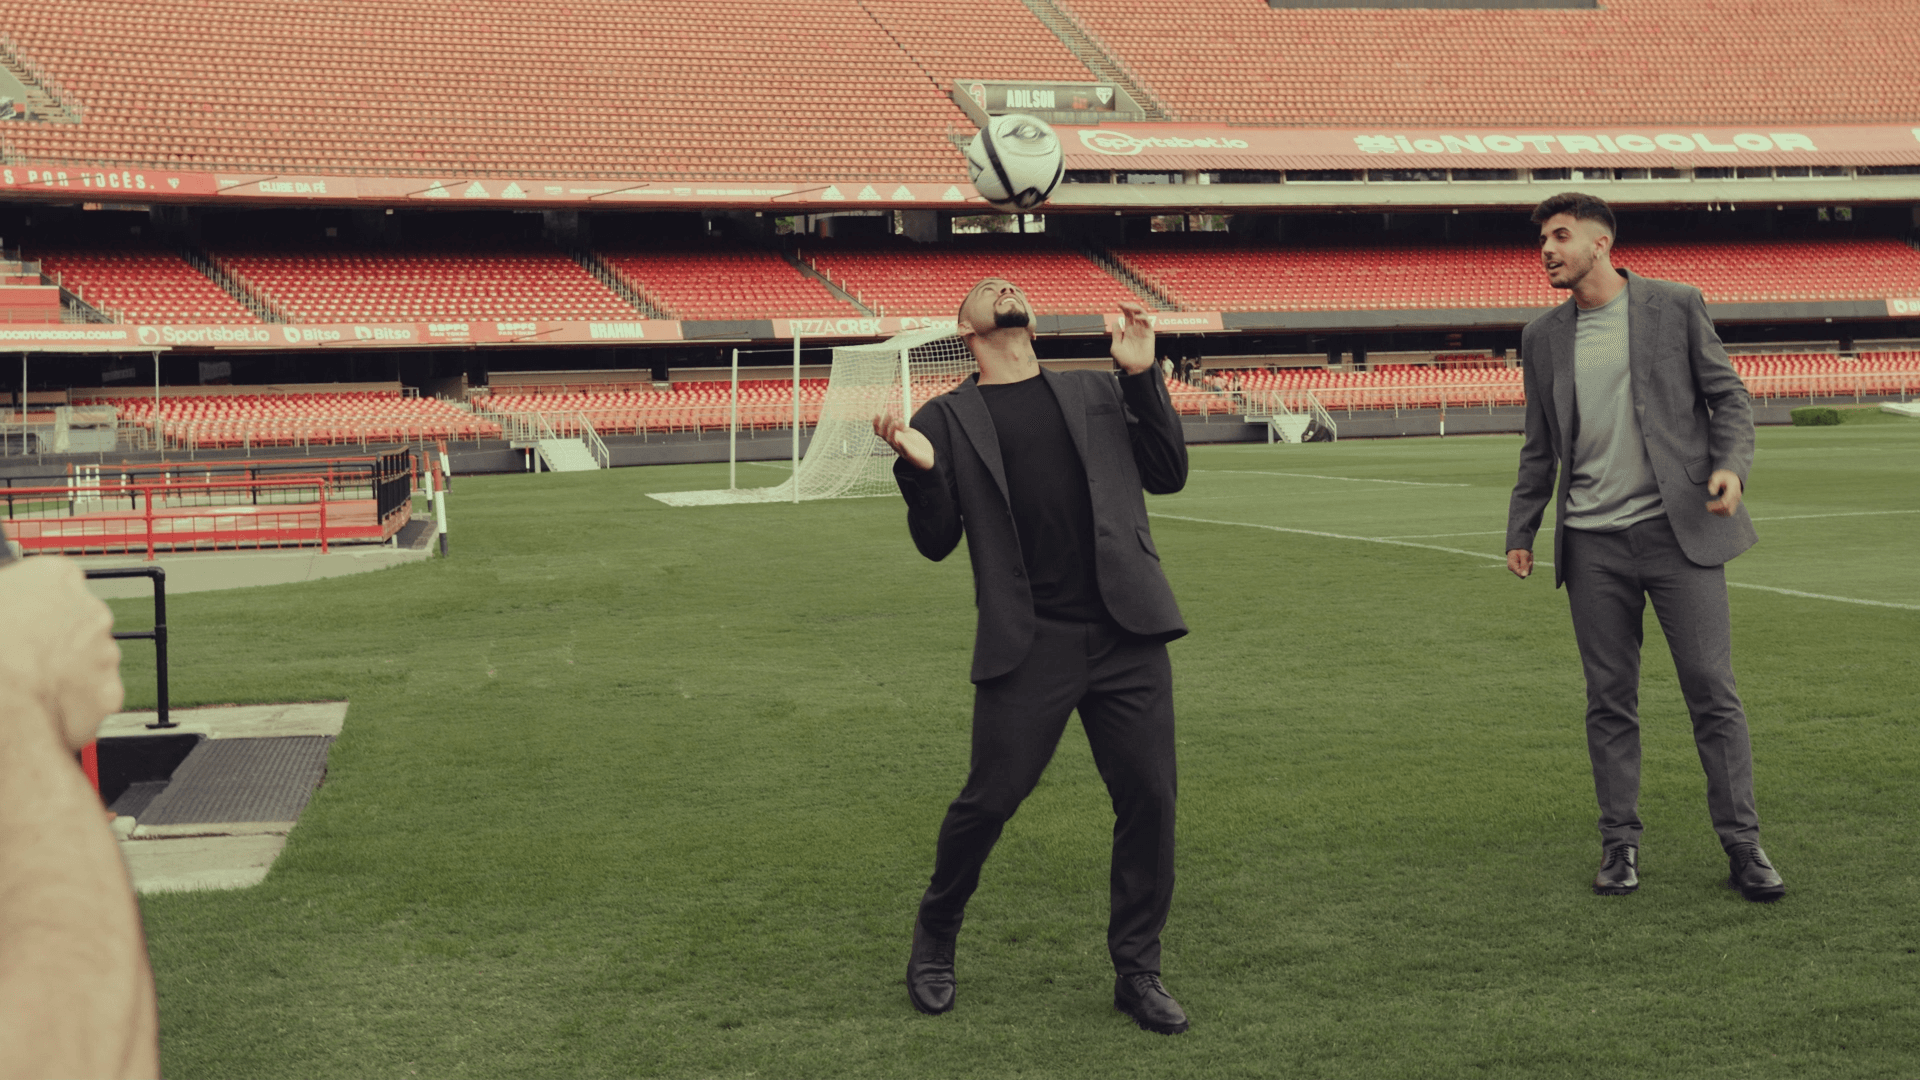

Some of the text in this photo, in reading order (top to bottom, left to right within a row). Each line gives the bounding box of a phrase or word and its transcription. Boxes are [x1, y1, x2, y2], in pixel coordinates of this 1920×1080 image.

[1006, 89, 1056, 109] ADILSON
[1353, 133, 1818, 153] #ioNOTRICOLOR
[28, 170, 69, 187] POR
[81, 171, 155, 189] VOCÊS.
[259, 180, 327, 194] CLUBE DA FÉ
[162, 325, 270, 344] Sportsbet.io
[302, 328, 340, 341] Bitso
[373, 327, 411, 340] Bitso
[590, 323, 644, 338] BRAHMA
